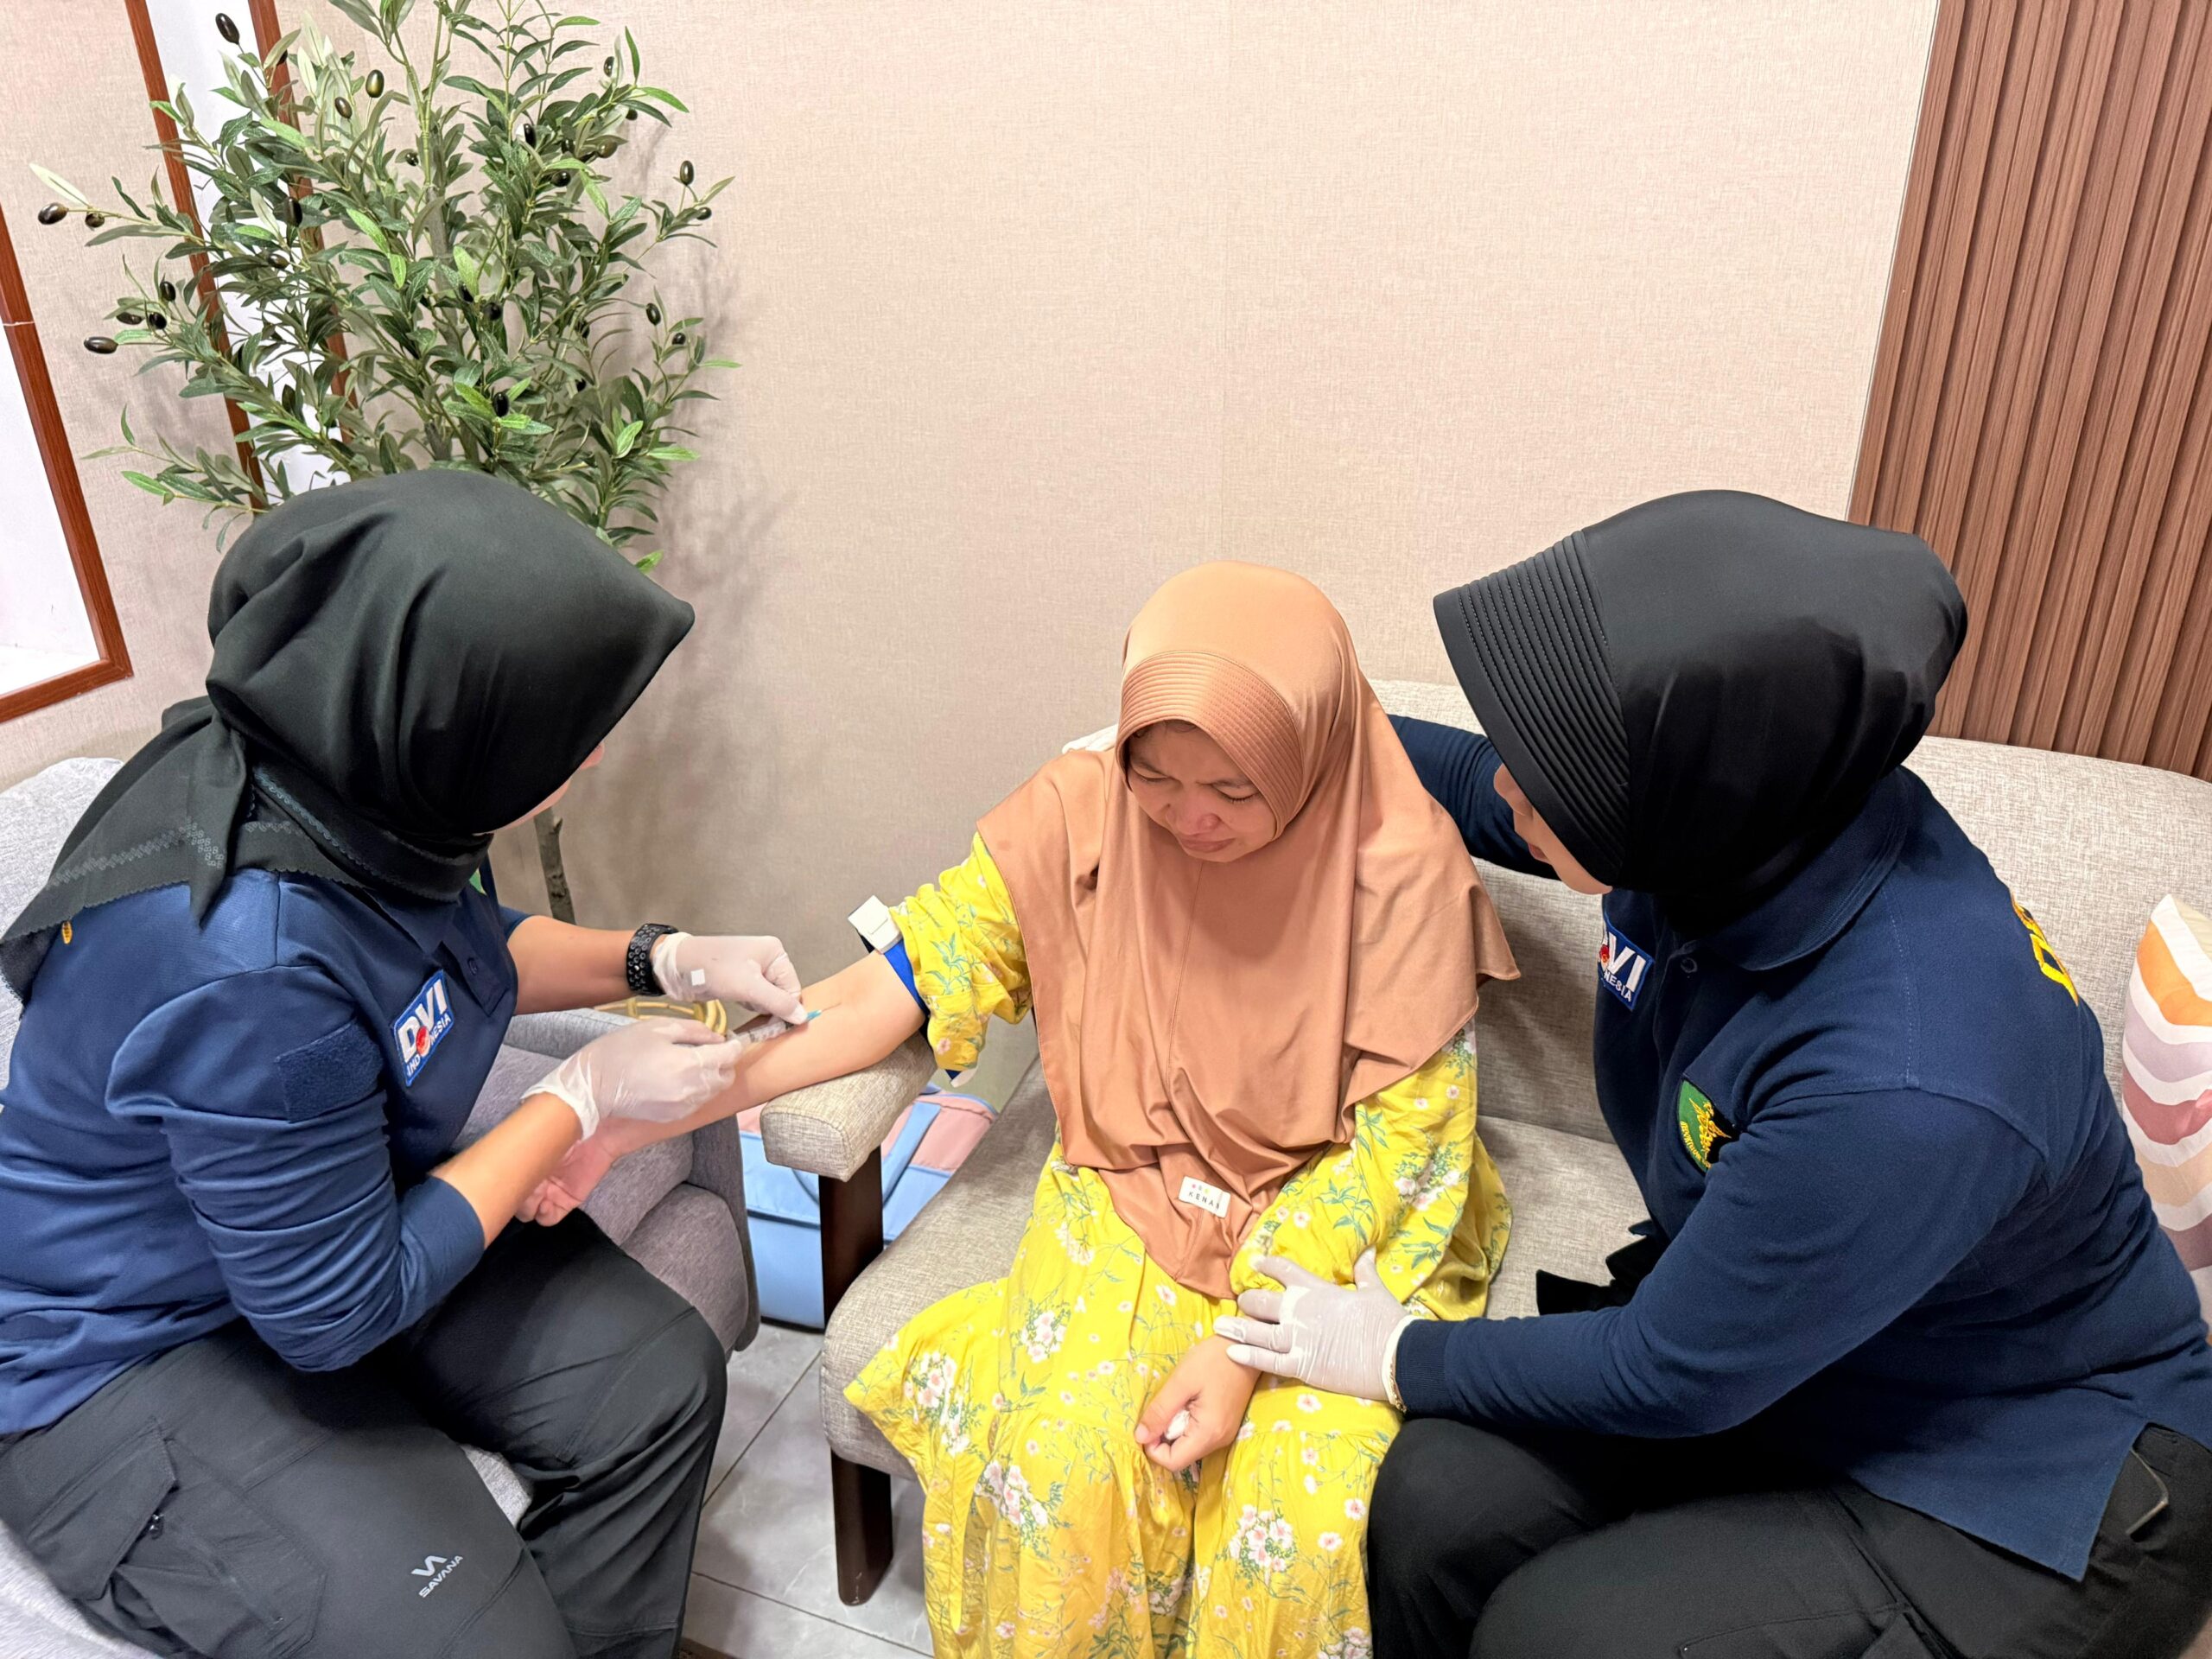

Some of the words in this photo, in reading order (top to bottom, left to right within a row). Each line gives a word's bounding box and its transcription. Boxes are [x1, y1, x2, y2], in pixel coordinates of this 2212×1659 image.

[1602, 928, 1646, 993] VI
[397, 979, 448, 1064] DVI
[418, 1555, 464, 1598] SAVANA
